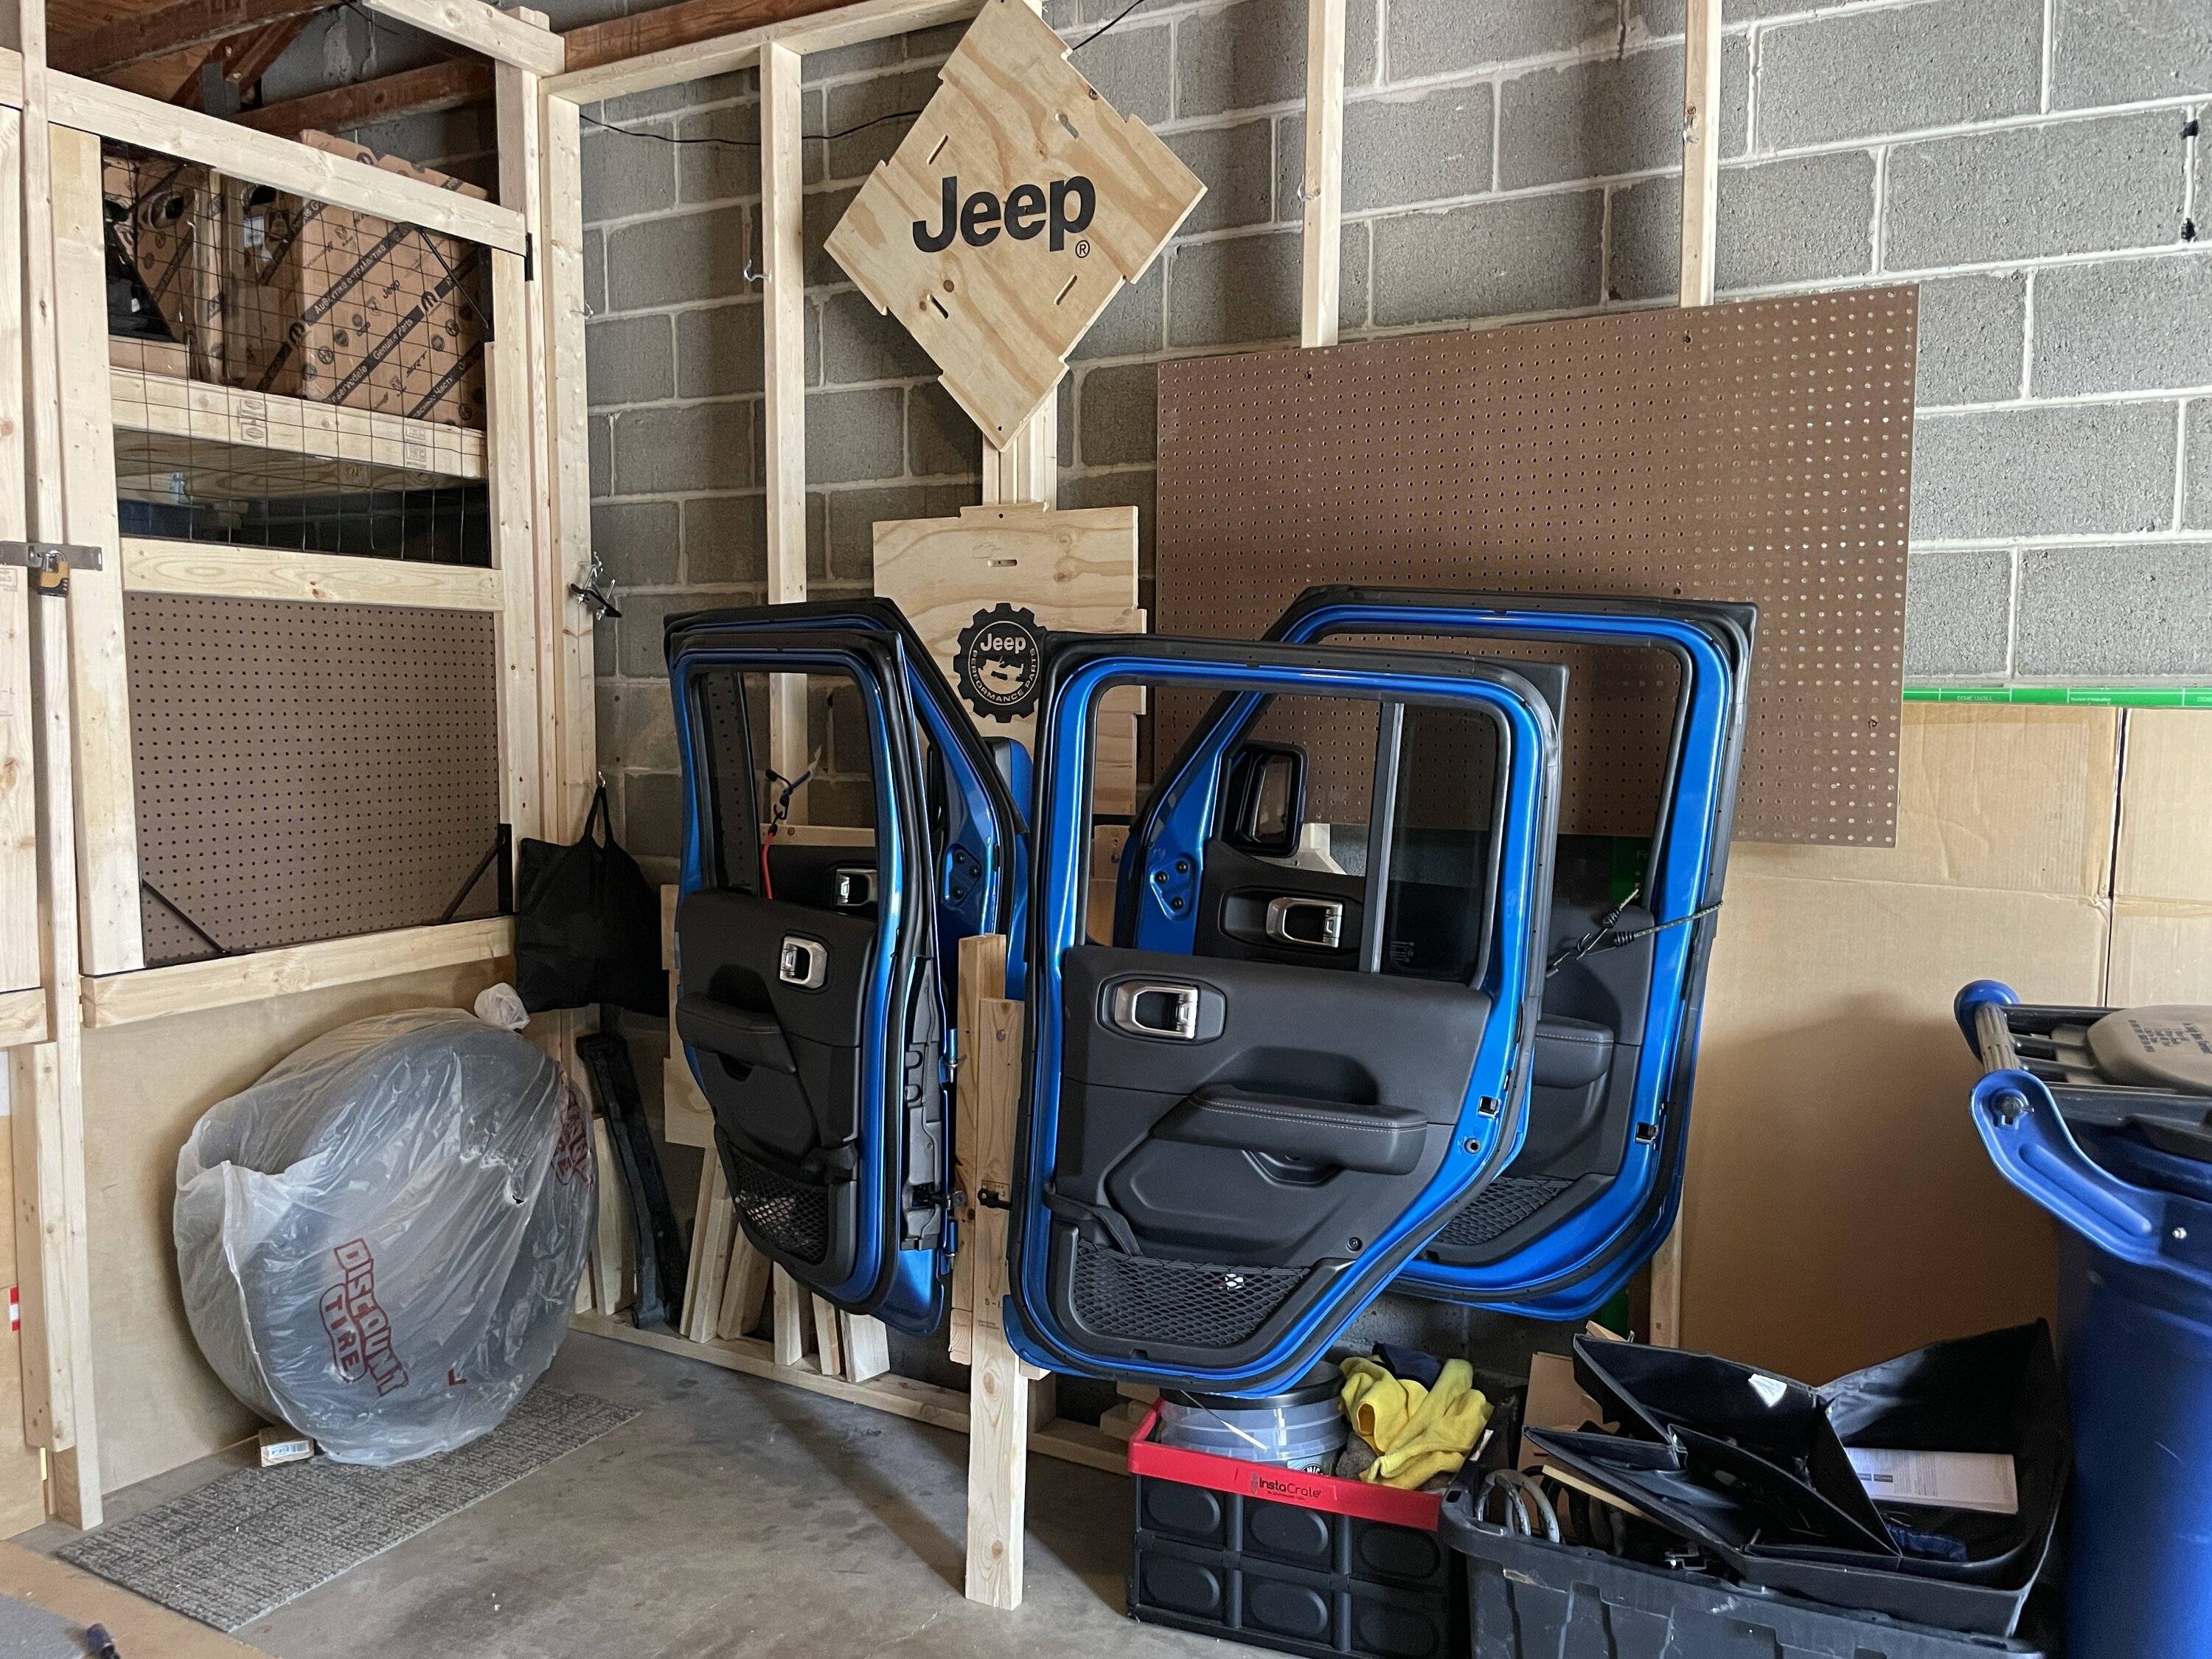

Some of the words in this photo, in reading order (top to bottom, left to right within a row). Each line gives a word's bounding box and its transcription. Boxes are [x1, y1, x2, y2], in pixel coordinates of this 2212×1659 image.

[913, 175, 1096, 253] Jeep
[383, 279, 400, 299] Jeep
[980, 633, 1026, 654] Jeep
[970, 650, 1024, 702] PERFORMANCE
[1025, 647, 1037, 688] PARTS
[324, 1293, 360, 1372] TIRE
[333, 1237, 409, 1397] DISCOUNT
[1259, 1477, 1320, 1498] InstaCrate
